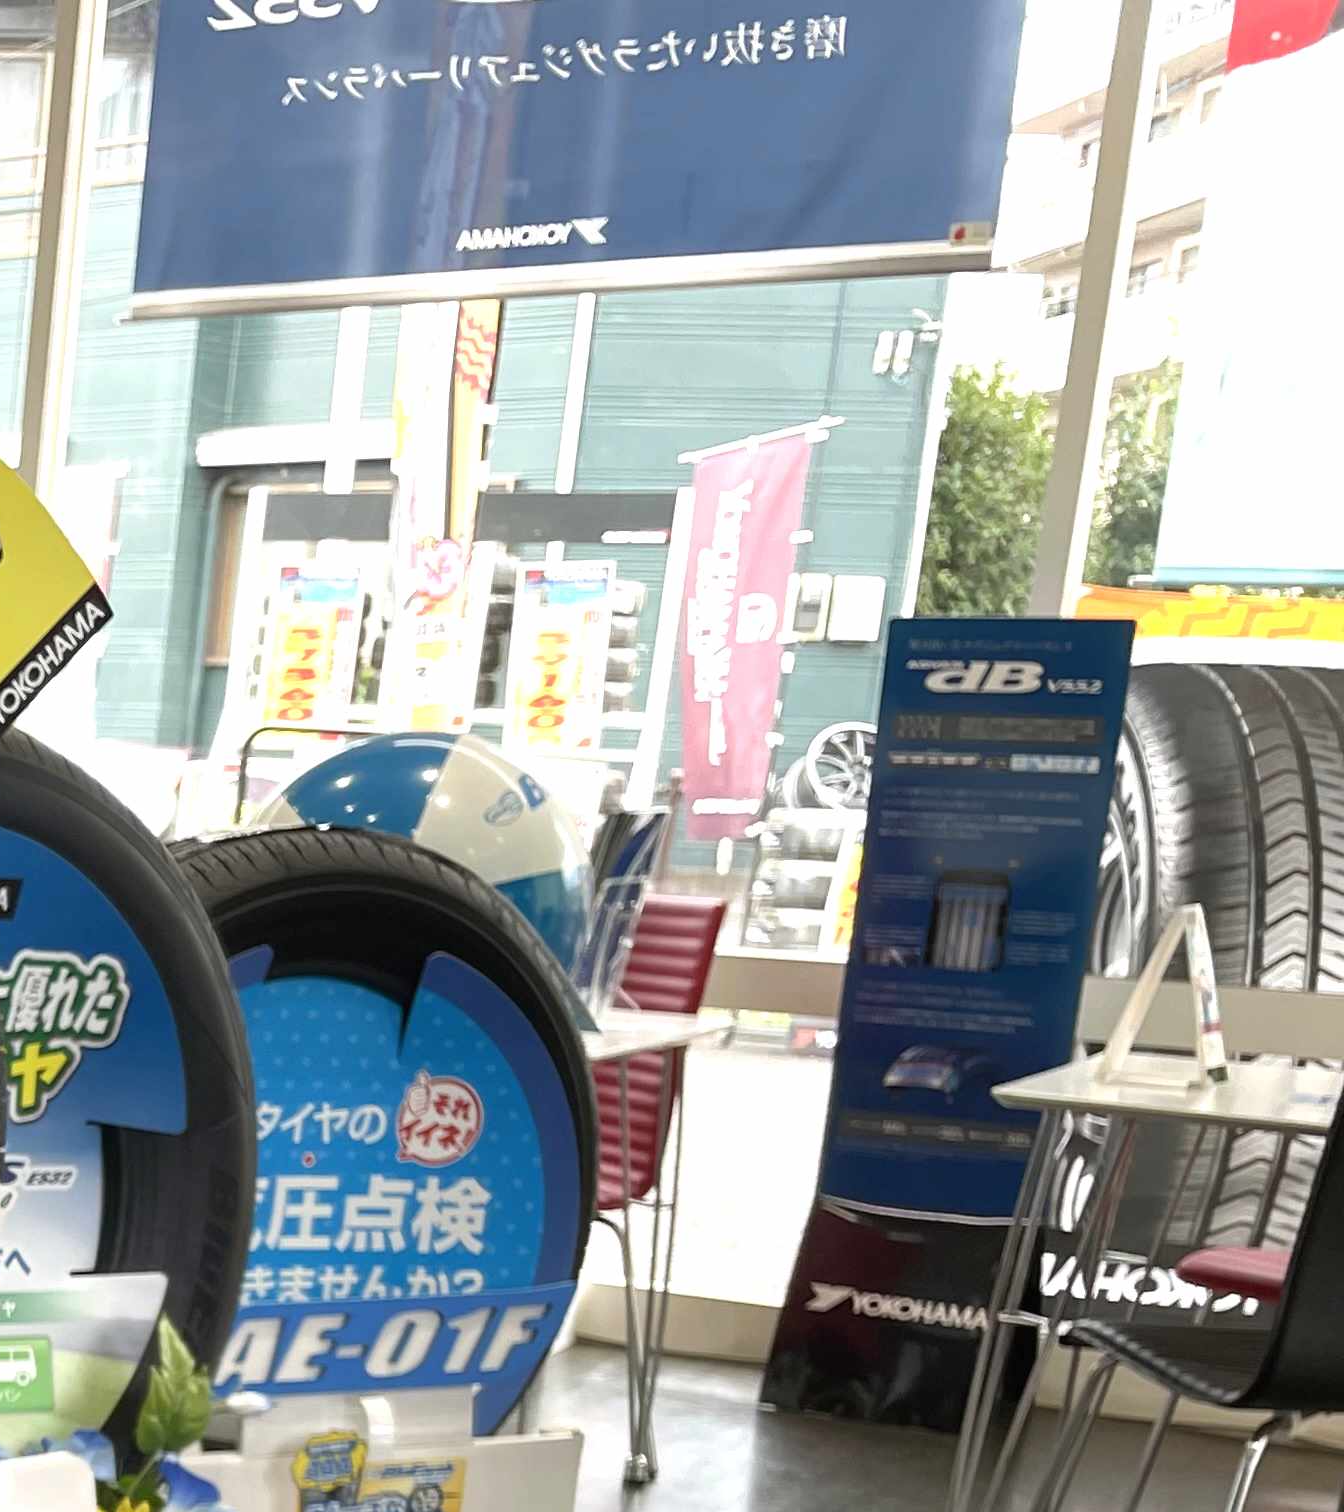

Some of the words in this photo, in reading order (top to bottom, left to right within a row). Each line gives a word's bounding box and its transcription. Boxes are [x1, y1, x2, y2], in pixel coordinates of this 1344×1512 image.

[924, 660, 1045, 694] dB
[256, 1101, 388, 1145] タイヤの
[852, 1291, 989, 1331] YOKOHAMA
[214, 1303, 548, 1388] AE-01F
